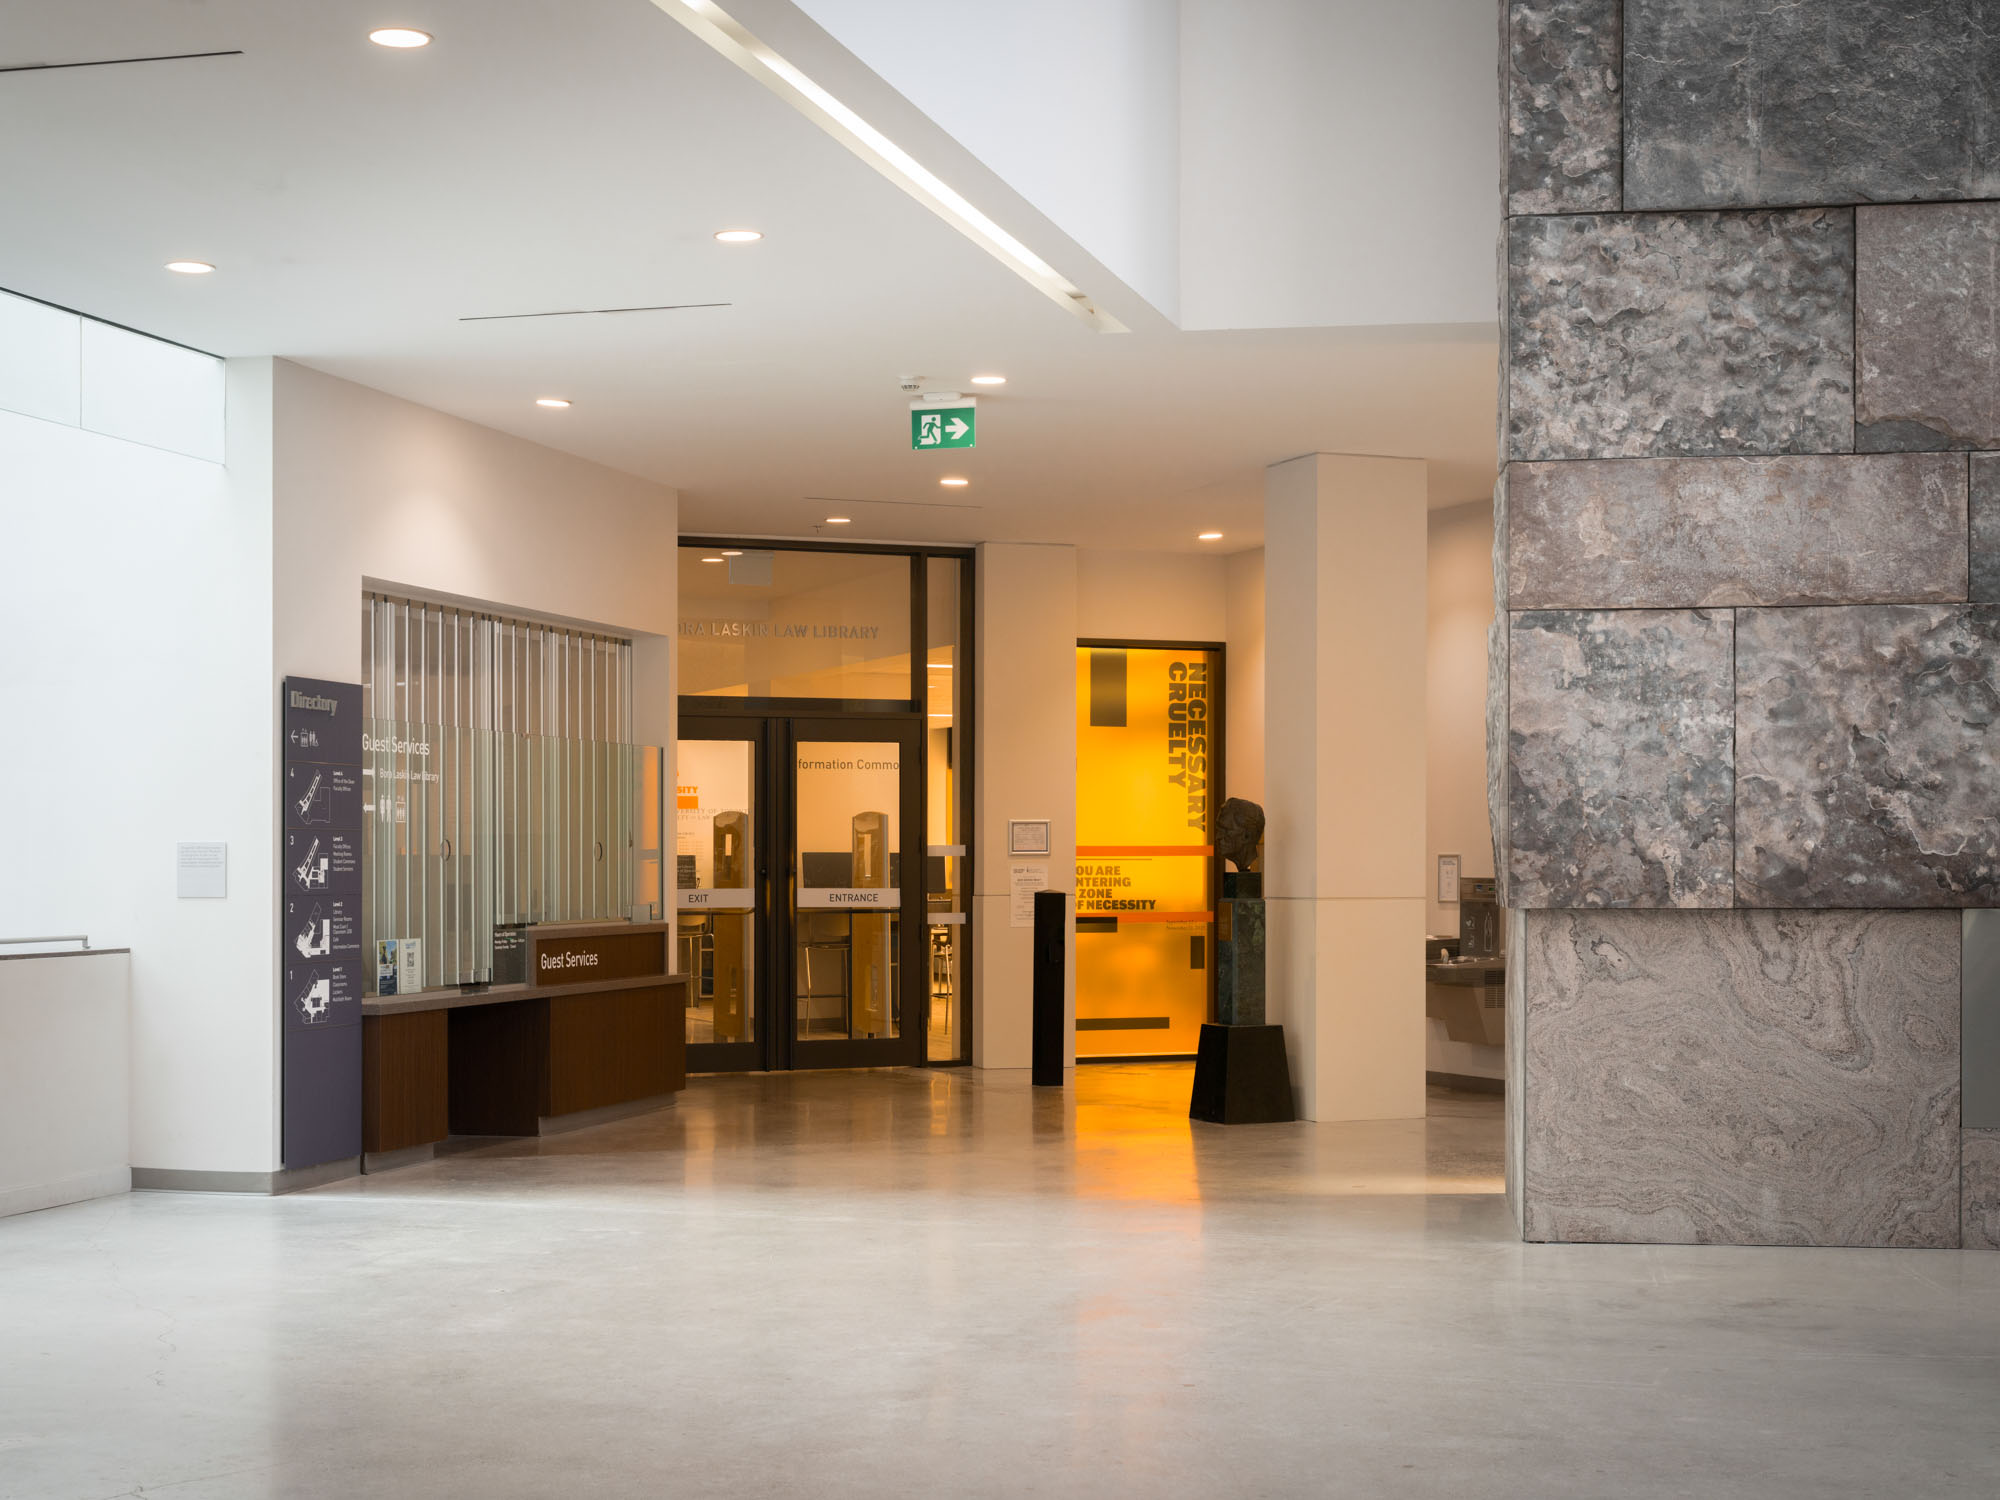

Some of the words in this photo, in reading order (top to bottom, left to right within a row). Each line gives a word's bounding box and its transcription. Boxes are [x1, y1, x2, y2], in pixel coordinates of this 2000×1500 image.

[711, 622, 769, 637] LASKIN
[774, 624, 808, 638] LAW
[813, 624, 879, 640] LIBRARY
[290, 690, 338, 716] Directory
[1168, 661, 1187, 789] CRUELTY
[362, 733, 390, 753] Guest
[391, 735, 430, 756] Services
[1187, 662, 1207, 832] NECESSARY
[798, 757, 853, 770] formation
[290, 768, 295, 778] 4
[290, 836, 295, 846] 3
[1095, 865, 1121, 876] ARE
[1076, 877, 1131, 887] NTERING
[688, 894, 708, 903] EXIT
[829, 893, 879, 903] ENTRANCE
[1079, 888, 1113, 899] ZONE
[290, 903, 294, 913] 2
[1086, 899, 1156, 910] NECESSITY
[541, 952, 564, 970] Guest
[565, 950, 599, 968] Services
[290, 970, 294, 981] 1
